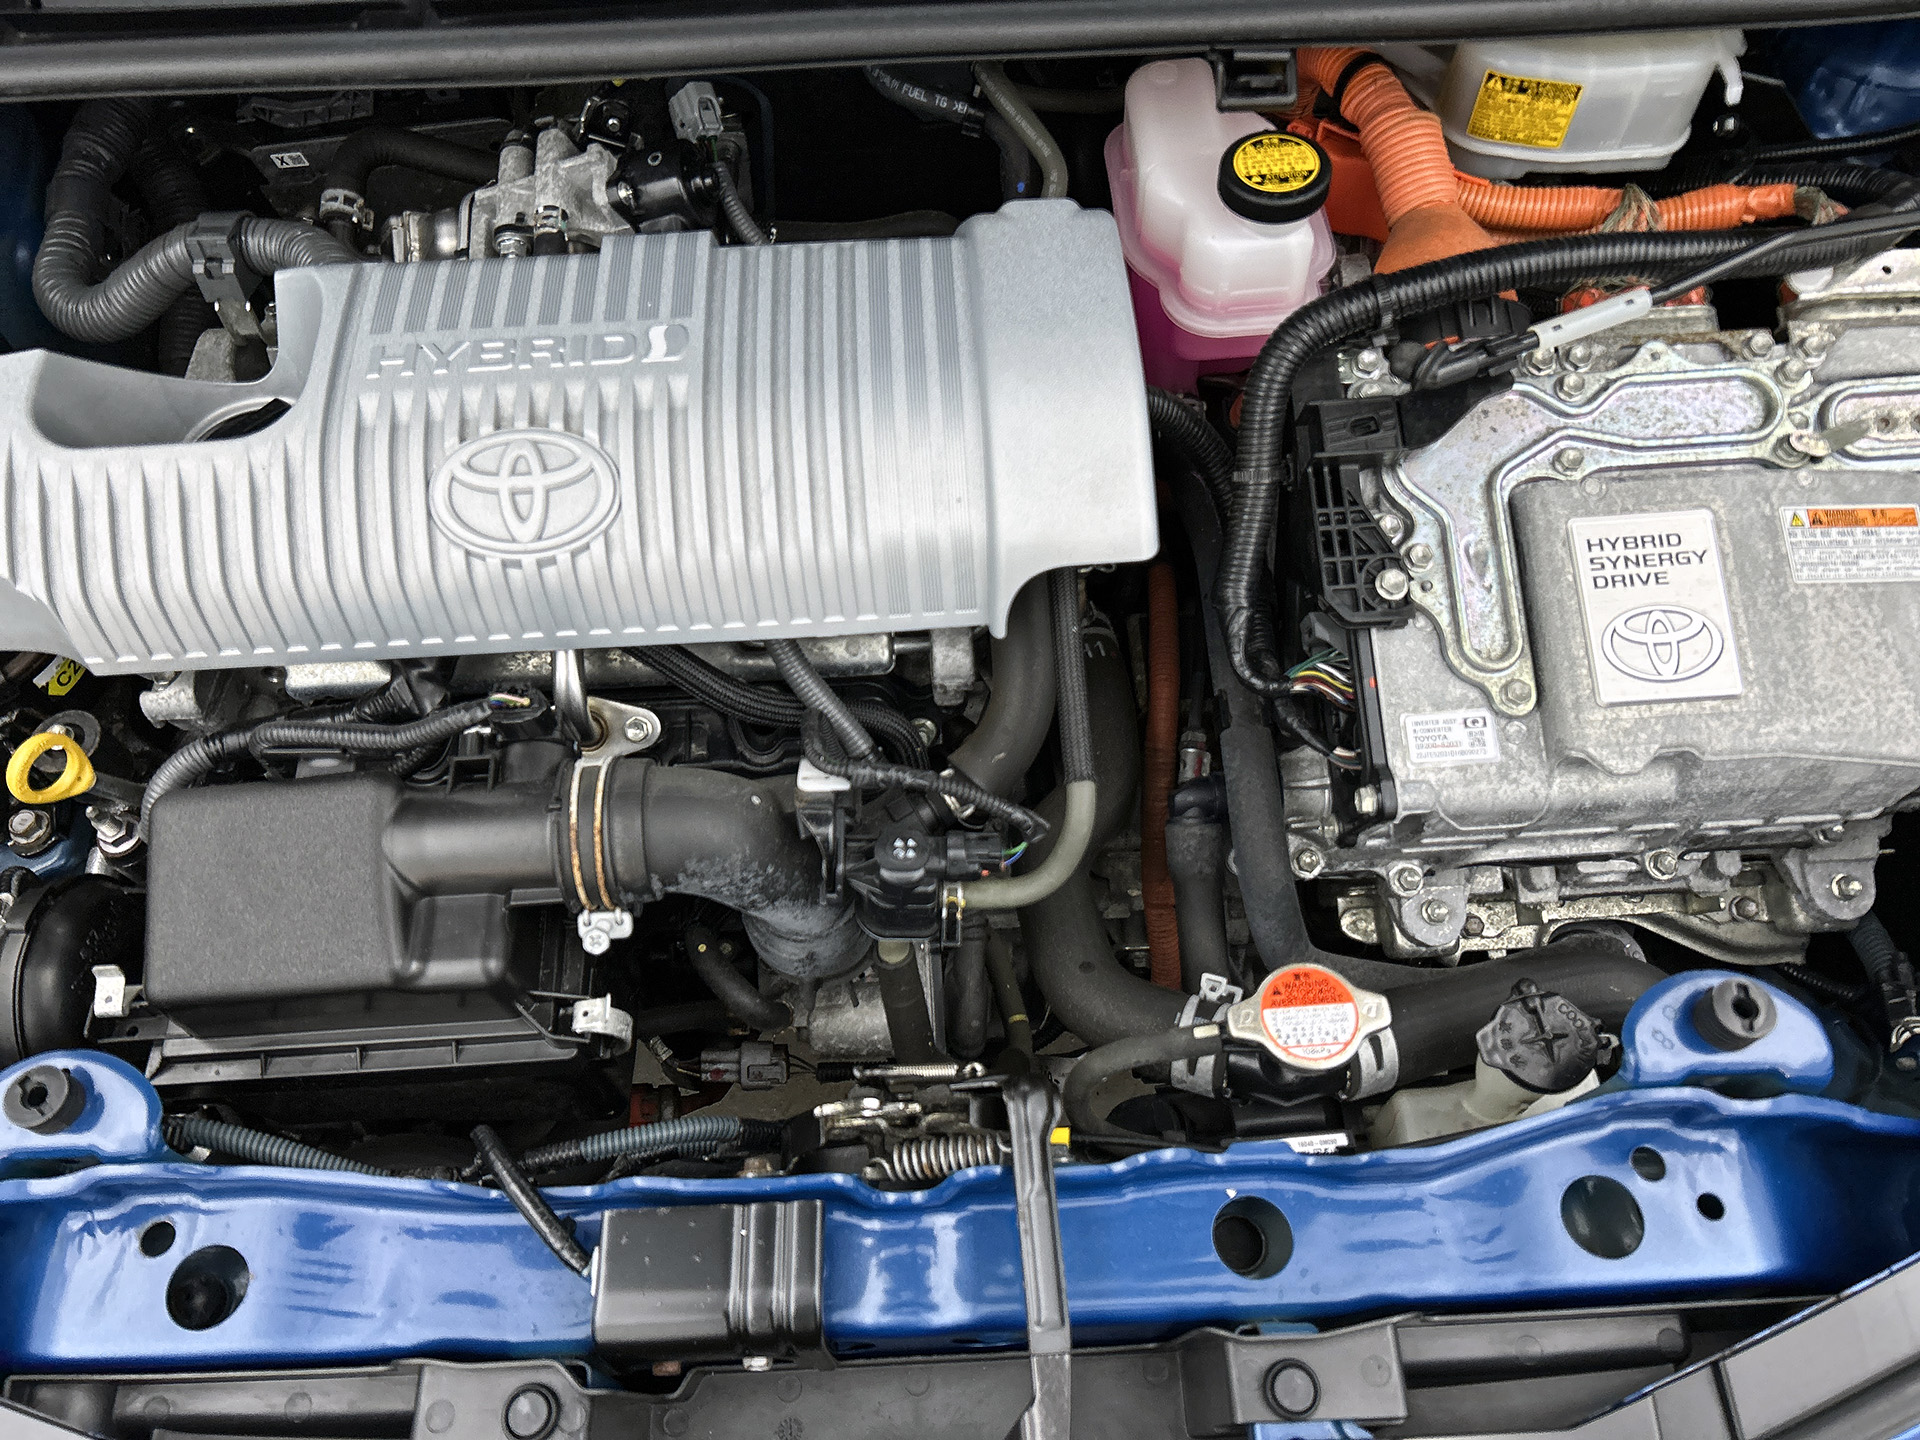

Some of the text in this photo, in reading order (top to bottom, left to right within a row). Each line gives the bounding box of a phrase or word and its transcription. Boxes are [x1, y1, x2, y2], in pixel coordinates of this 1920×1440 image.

[901, 82, 928, 103] FUEL
[934, 93, 948, 109] TG
[365, 331, 637, 380] HYBRID
[1586, 532, 1682, 553] HYBRID
[1589, 549, 1708, 572] SYNERGY
[1592, 570, 1670, 590] DRIVE
[56, 660, 82, 687] C2
[1411, 718, 1440, 728] INVERTER
[1413, 734, 1448, 742] TOYOTA
[1283, 979, 1329, 990] WARNING
